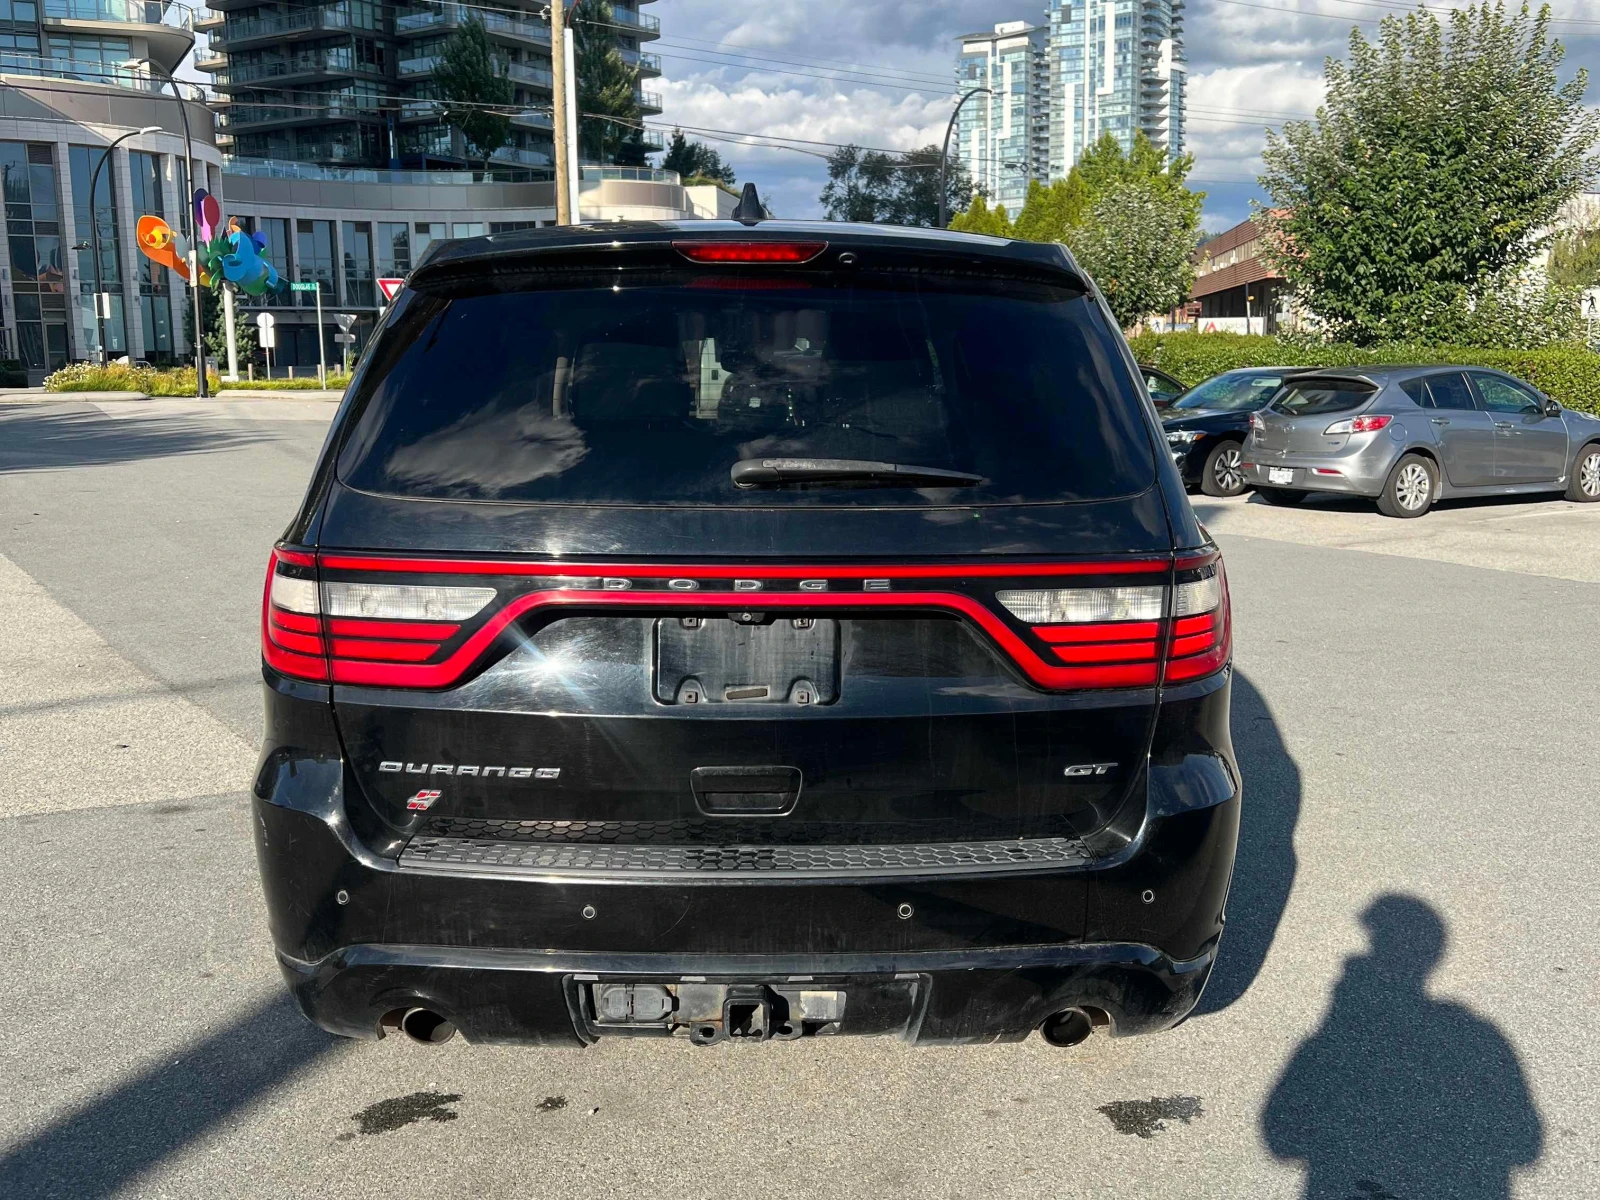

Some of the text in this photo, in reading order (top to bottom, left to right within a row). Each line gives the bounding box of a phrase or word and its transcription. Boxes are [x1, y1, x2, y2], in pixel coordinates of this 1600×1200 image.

[292, 283, 311, 291] DOUGLAS
[603, 578, 890, 592] DODGE
[378, 761, 561, 779] DURANGO
[1064, 762, 1118, 776] GT
